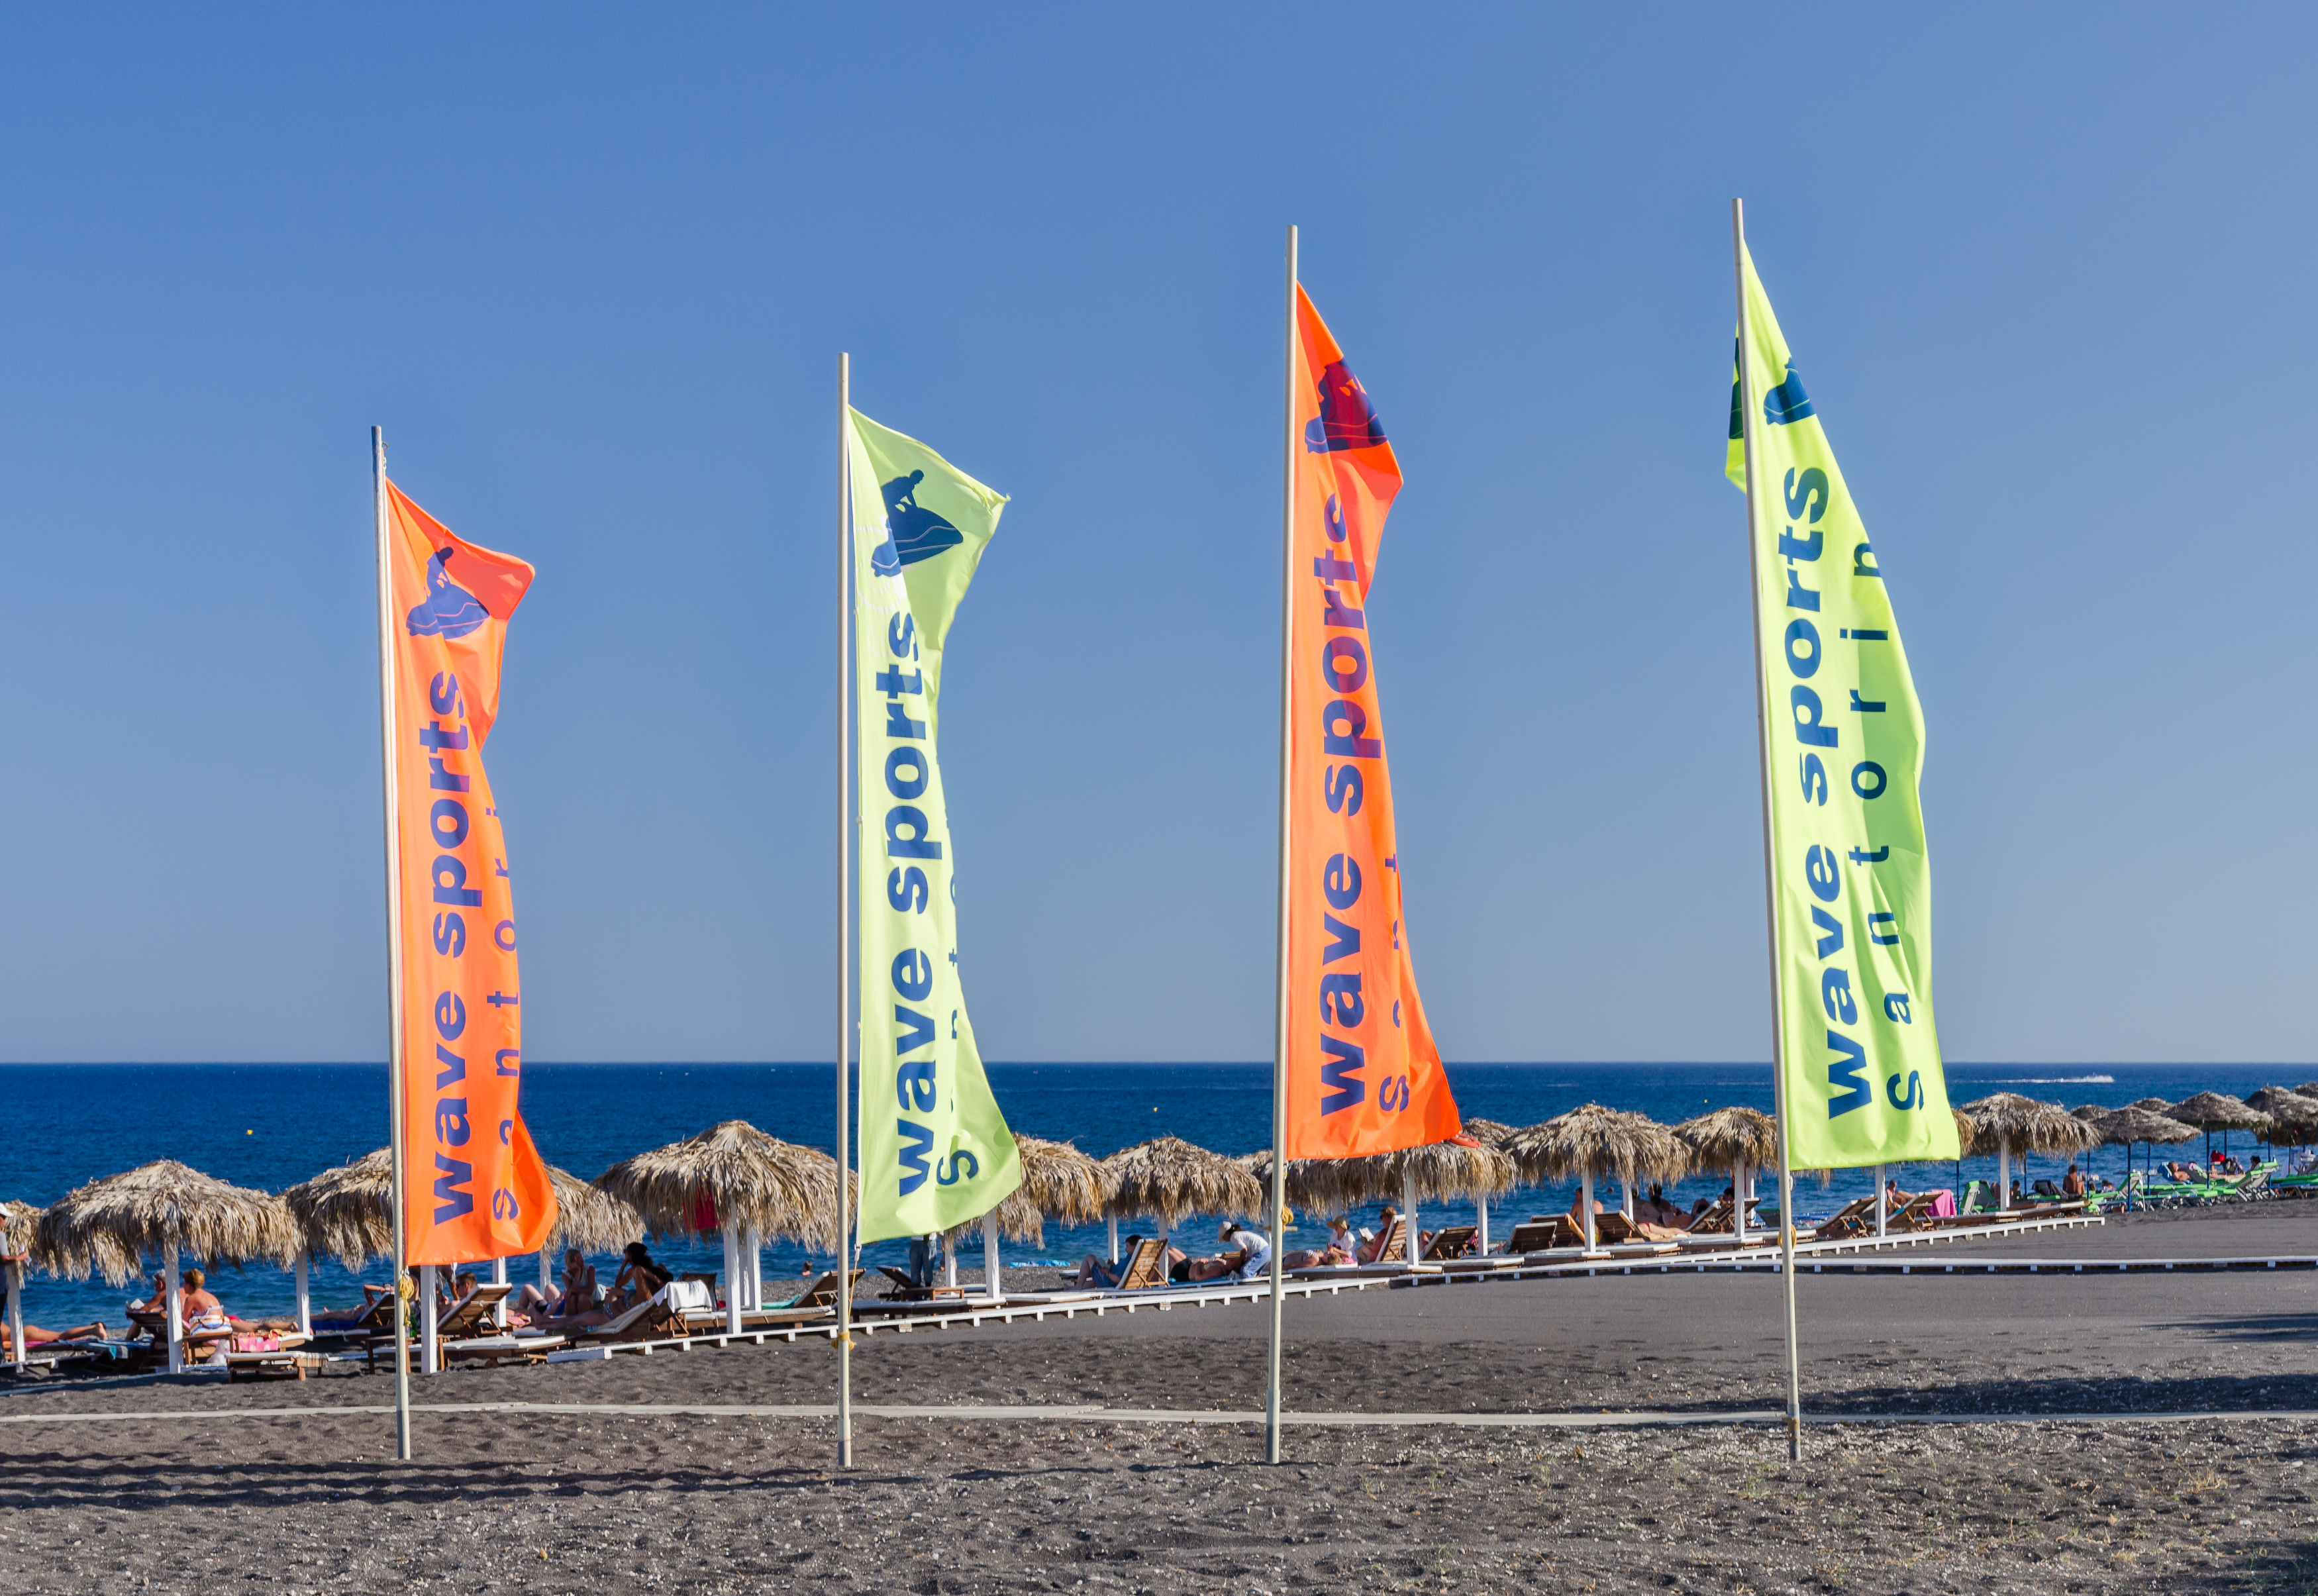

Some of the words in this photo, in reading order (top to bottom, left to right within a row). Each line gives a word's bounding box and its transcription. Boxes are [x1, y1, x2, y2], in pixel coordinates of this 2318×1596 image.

[876, 610, 942, 915] sports
[1778, 468, 1839, 807] sports
[419, 670, 482, 959] sports
[433, 991, 474, 1225] wave
[891, 948, 936, 1197] wave
[1319, 853, 1365, 1117] wave
[1805, 844, 1872, 1119] wave
